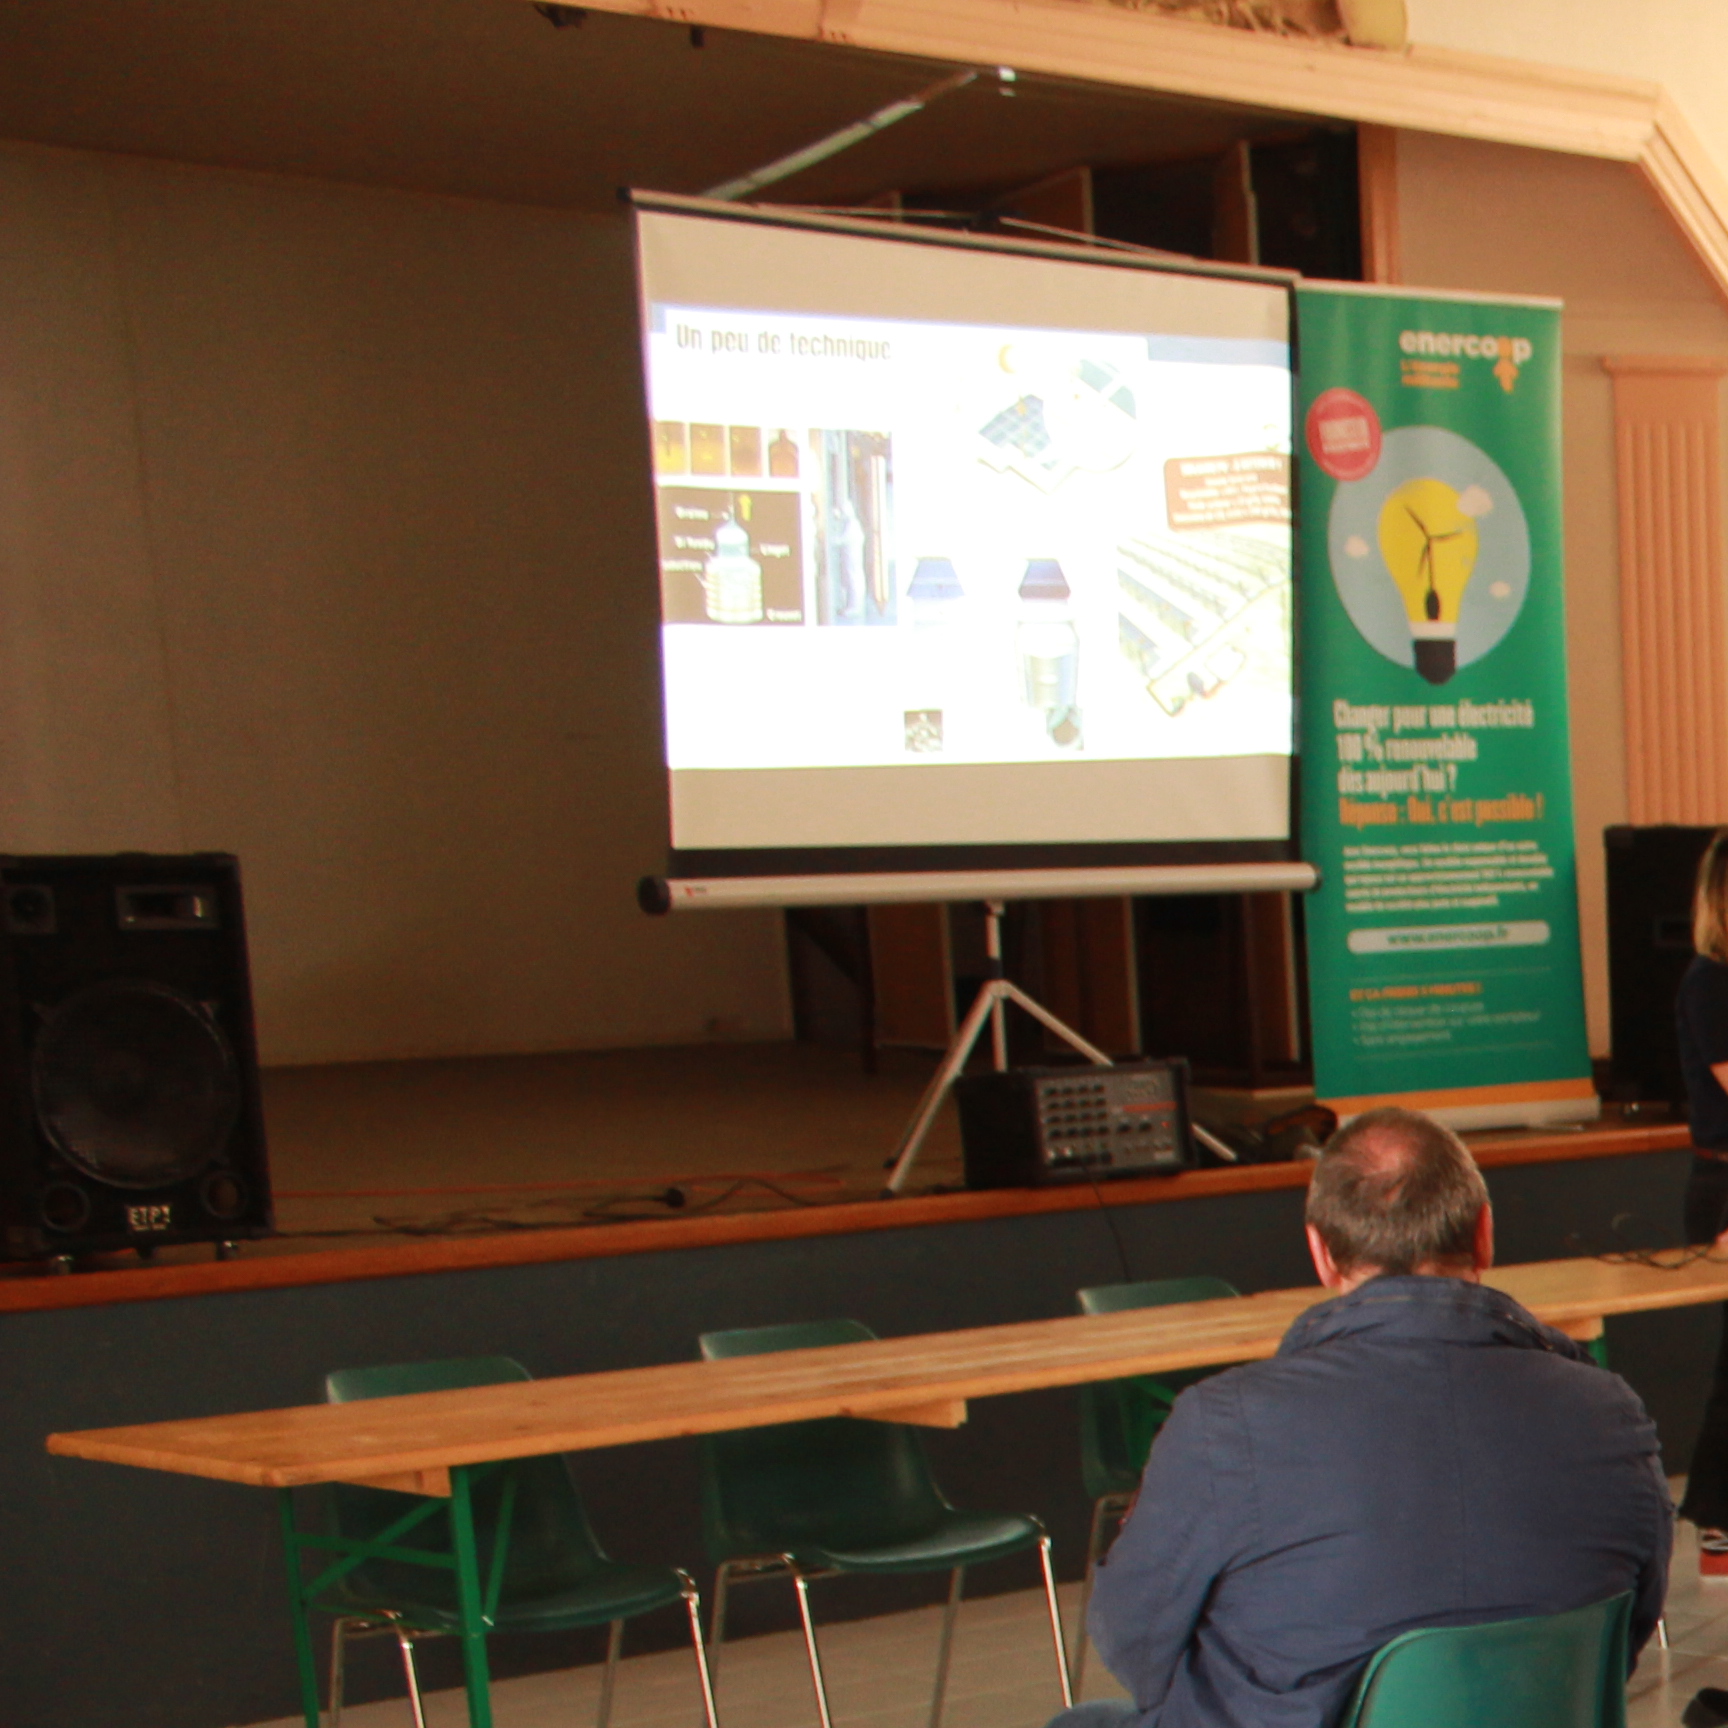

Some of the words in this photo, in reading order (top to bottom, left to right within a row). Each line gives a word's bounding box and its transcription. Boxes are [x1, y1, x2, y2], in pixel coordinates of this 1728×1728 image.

[676, 323, 702, 350] Un
[711, 330, 749, 354] peu
[757, 331, 781, 354] de
[790, 332, 891, 361] technique
[1399, 330, 1532, 365] enercoop
[1333, 699, 1391, 732] Changer
[1458, 698, 1534, 729] électricité
